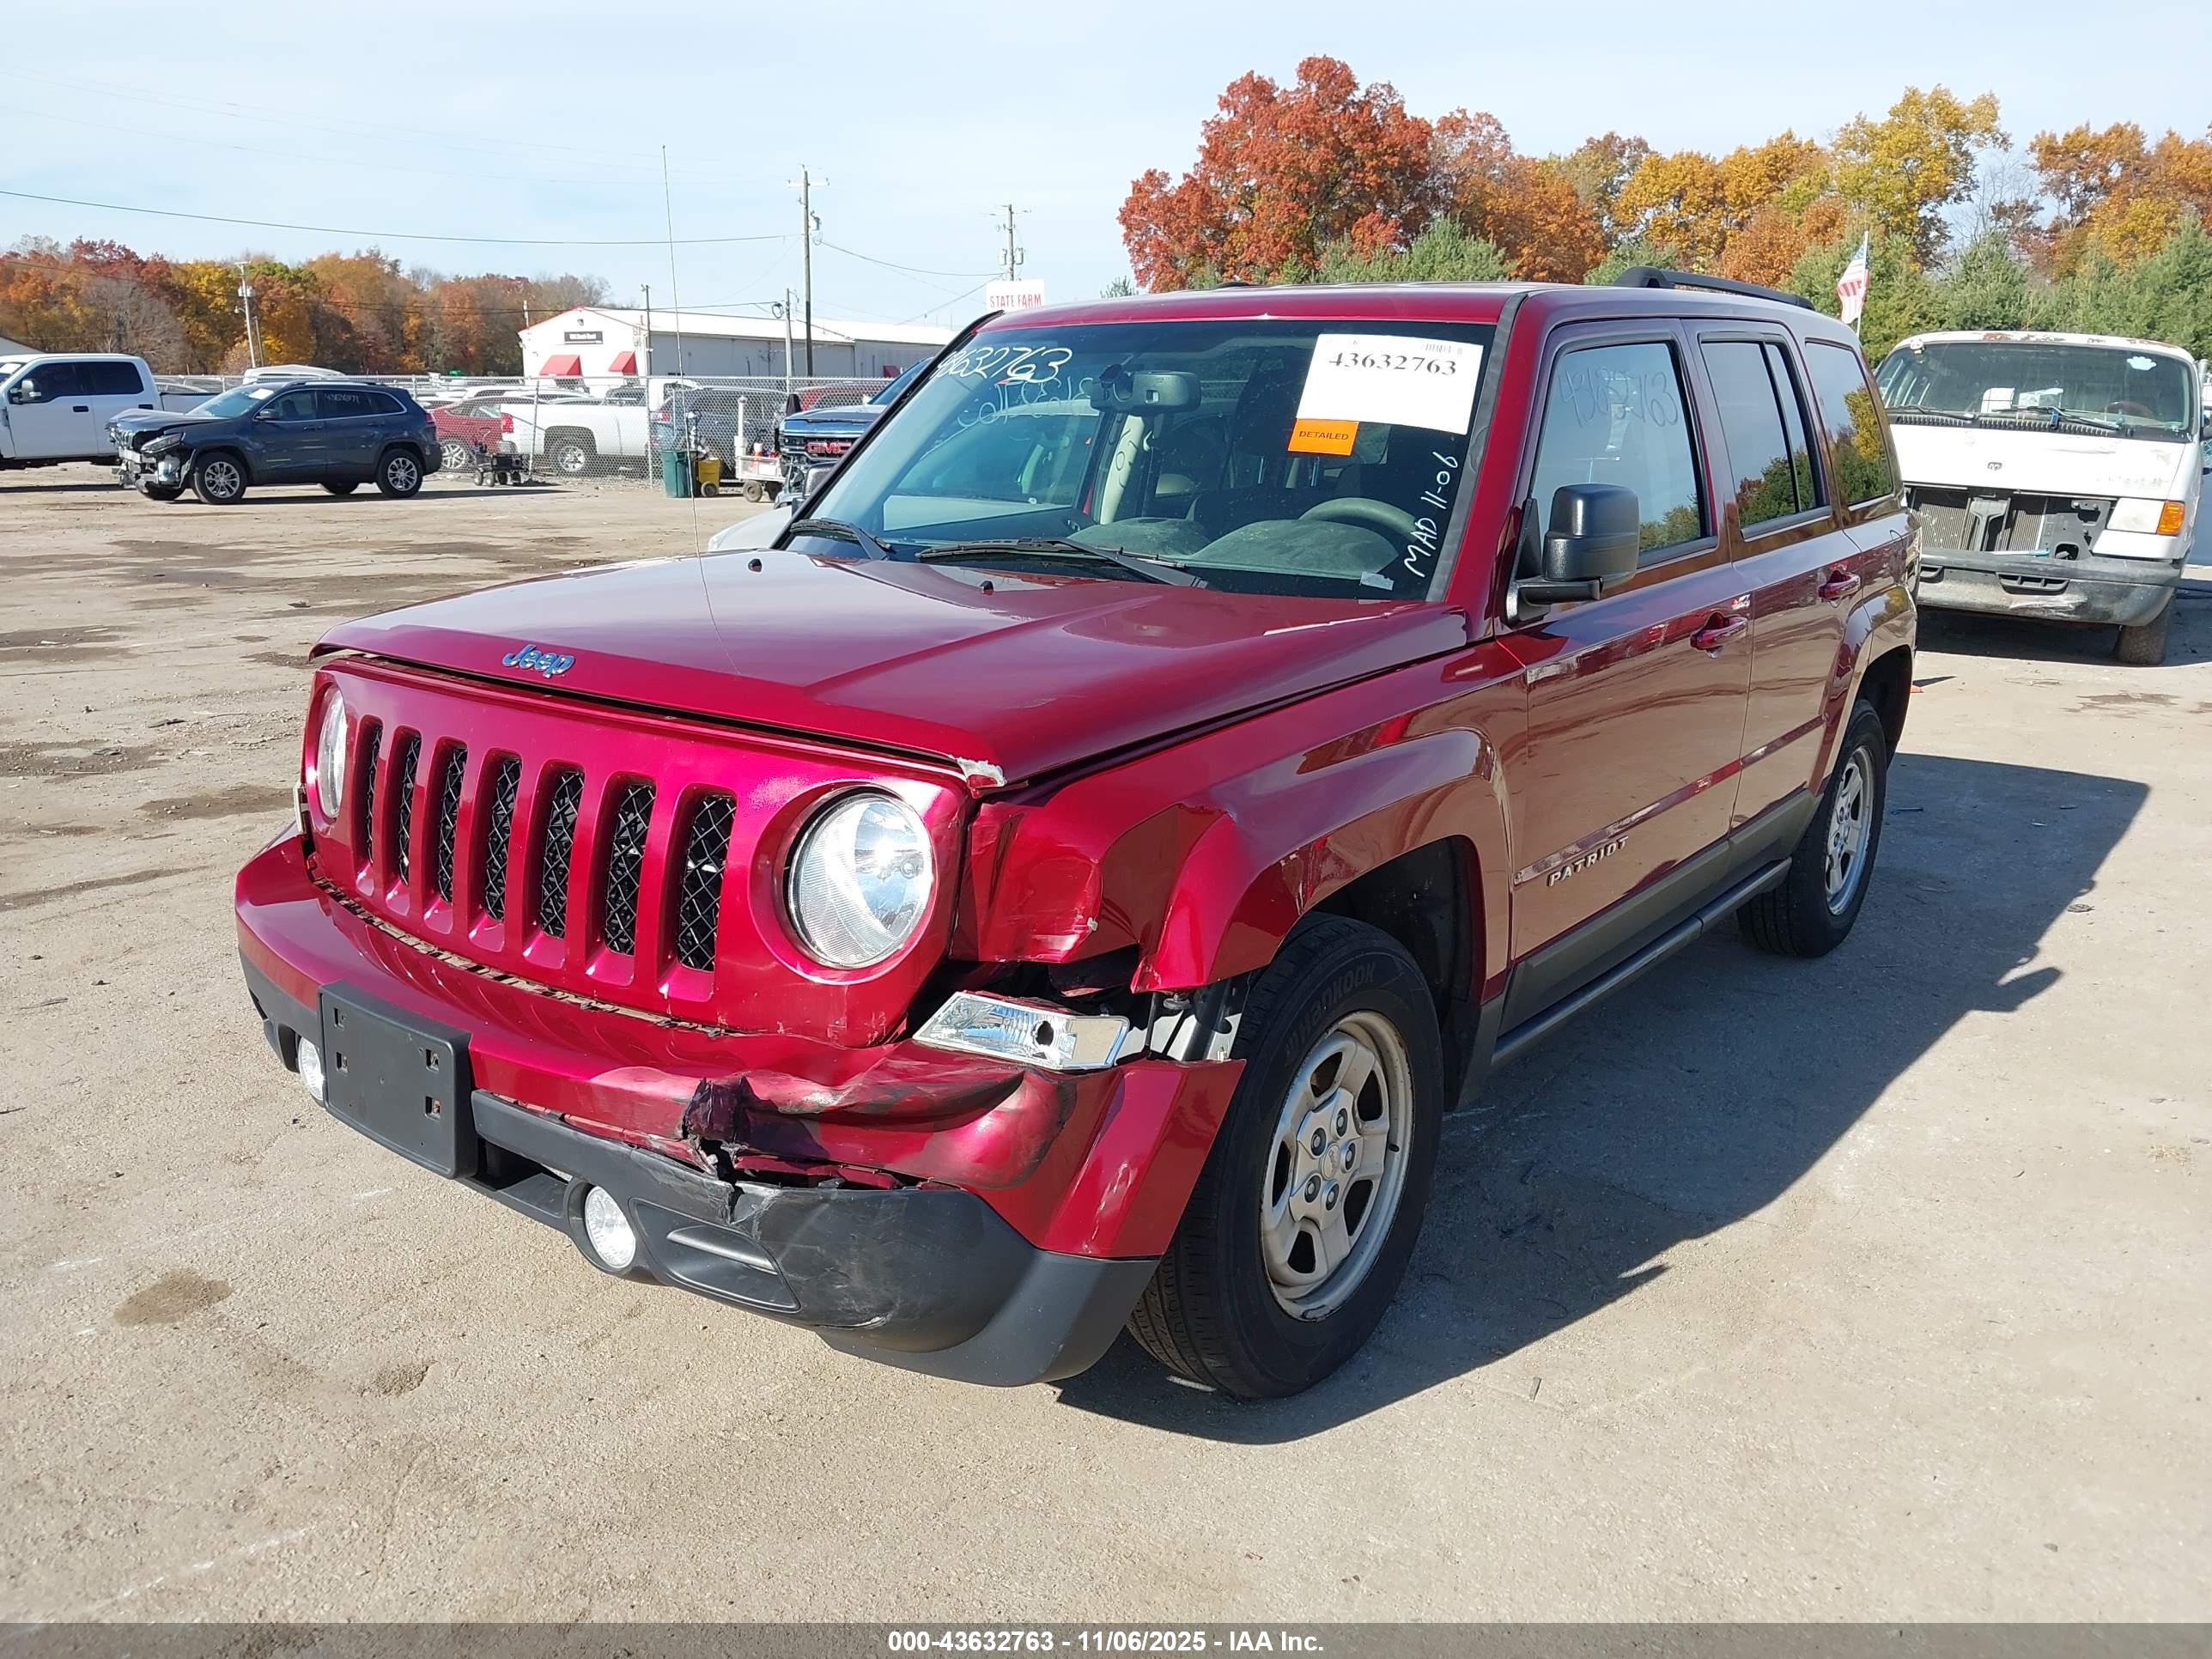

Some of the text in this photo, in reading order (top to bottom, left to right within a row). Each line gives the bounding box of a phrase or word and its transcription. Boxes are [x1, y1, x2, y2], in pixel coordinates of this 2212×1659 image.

[989, 293, 1042, 309] STATE FARM
[1328, 351, 1457, 376] 43632763
[807, 441, 852, 454] GMC
[1298, 430, 1350, 441] DETAILED
[1403, 451, 1459, 578] MAD 11-06
[501, 643, 575, 678] Jeep
[1547, 835, 1629, 887] PATRIOT
